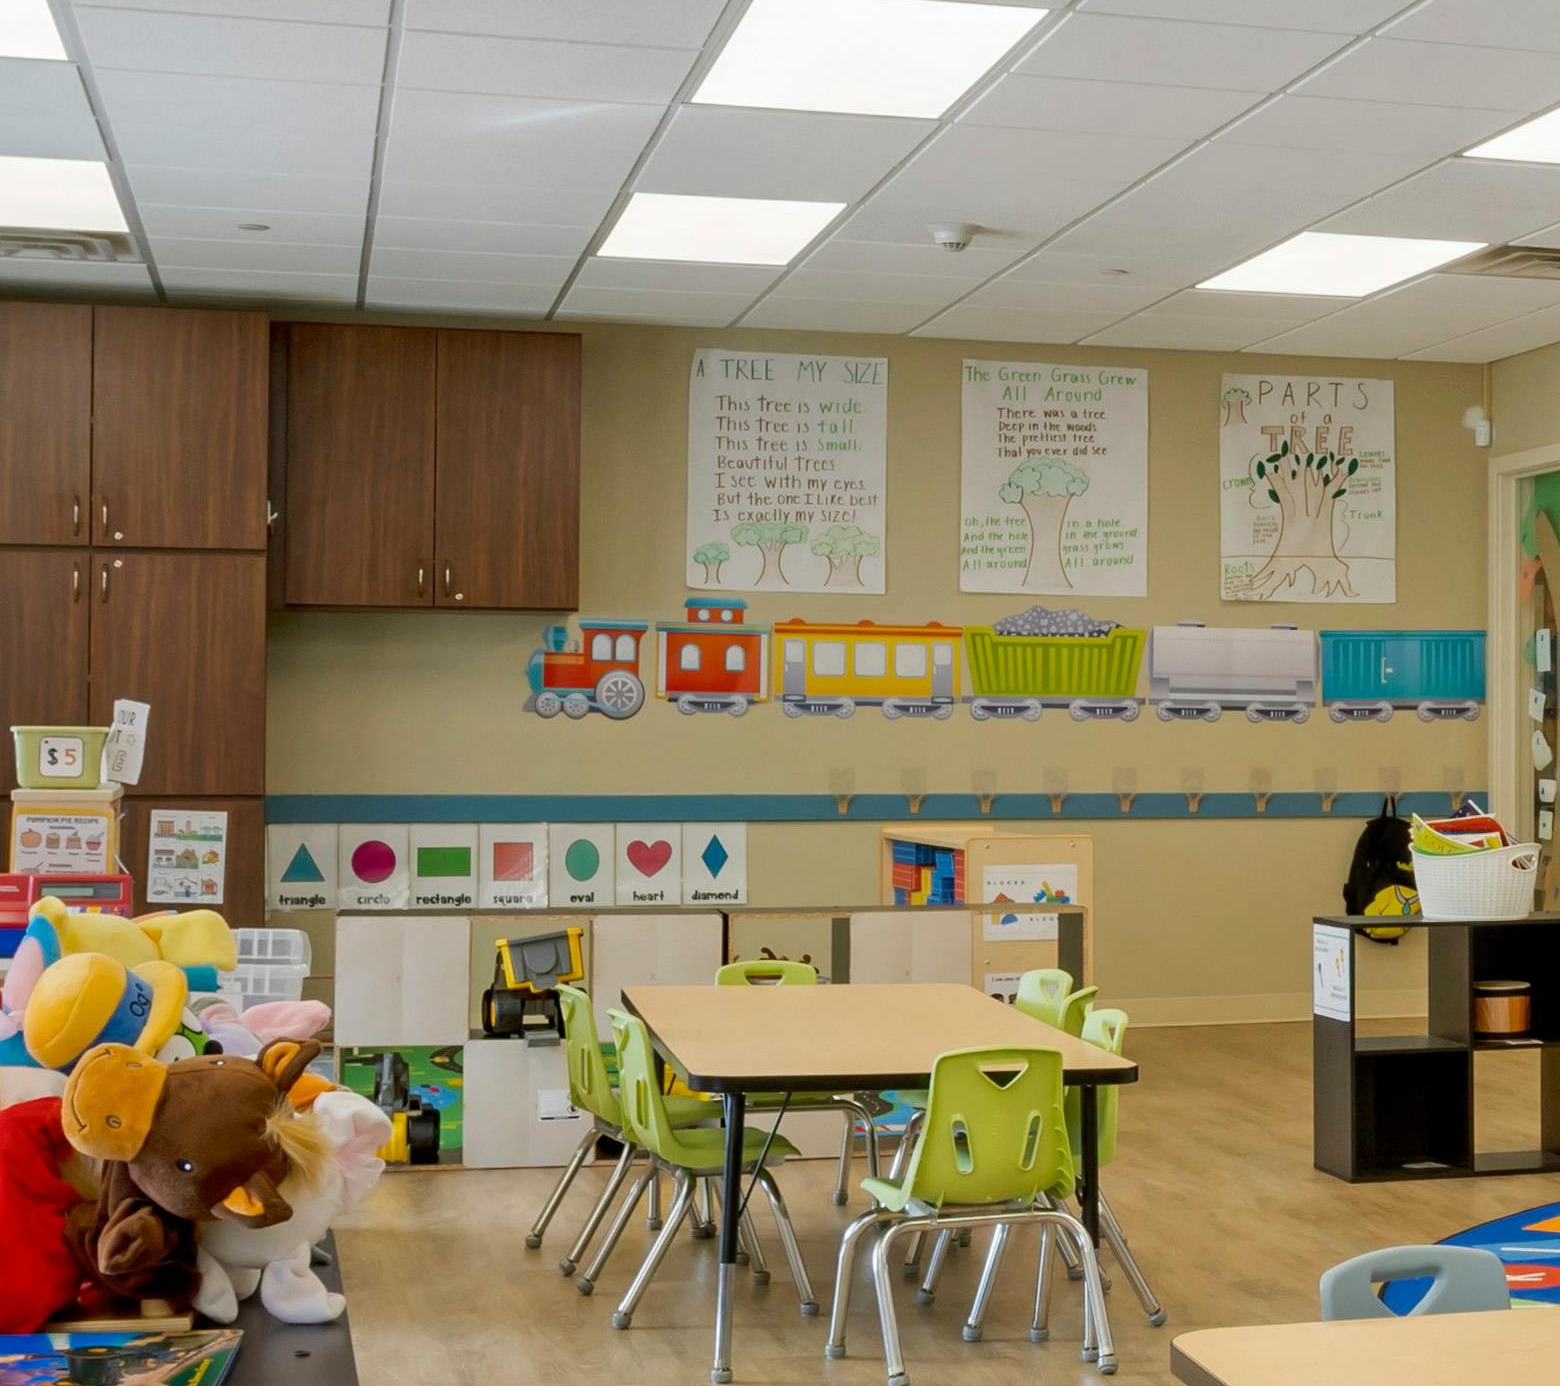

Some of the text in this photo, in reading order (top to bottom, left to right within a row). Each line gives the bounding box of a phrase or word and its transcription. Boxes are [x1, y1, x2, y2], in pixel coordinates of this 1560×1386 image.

[696, 360, 885, 385] A TREE MY SIZE
[965, 366, 1136, 386] The Green Grass Grew
[1002, 386, 1103, 402] All Around
[1258, 380, 1368, 410] PARTS
[715, 395, 750, 412] This
[757, 394, 791, 412] tree
[798, 399, 810, 413] is
[716, 417, 750, 432] This
[756, 416, 789, 433] tree
[798, 419, 809, 432] is
[1290, 412, 1332, 424] of a
[1261, 425, 1354, 455] TREE
[717, 455, 788, 470] Beautiful
[715, 473, 726, 488] I
[731, 475, 757, 488] see
[764, 474, 802, 490] with
[808, 479, 827, 492] my
[717, 493, 742, 506] But
[747, 493, 772, 506] the
[777, 494, 800, 505] one
[805, 494, 813, 505] I
[849, 494, 879, 506] best
[713, 510, 730, 522] Is
[738, 508, 790, 523] exactly
[795, 510, 815, 523] my
[1349, 510, 1384, 519] Trunk
[1224, 562, 1255, 575] Roots
[48, 748, 76, 765] $ 5
[280, 893, 326, 907] triangle
[416, 893, 472, 907] rectangle
[492, 894, 533, 907] square
[570, 892, 594, 903] oval
[633, 890, 664, 902] heart
[692, 889, 739, 902] diamond
